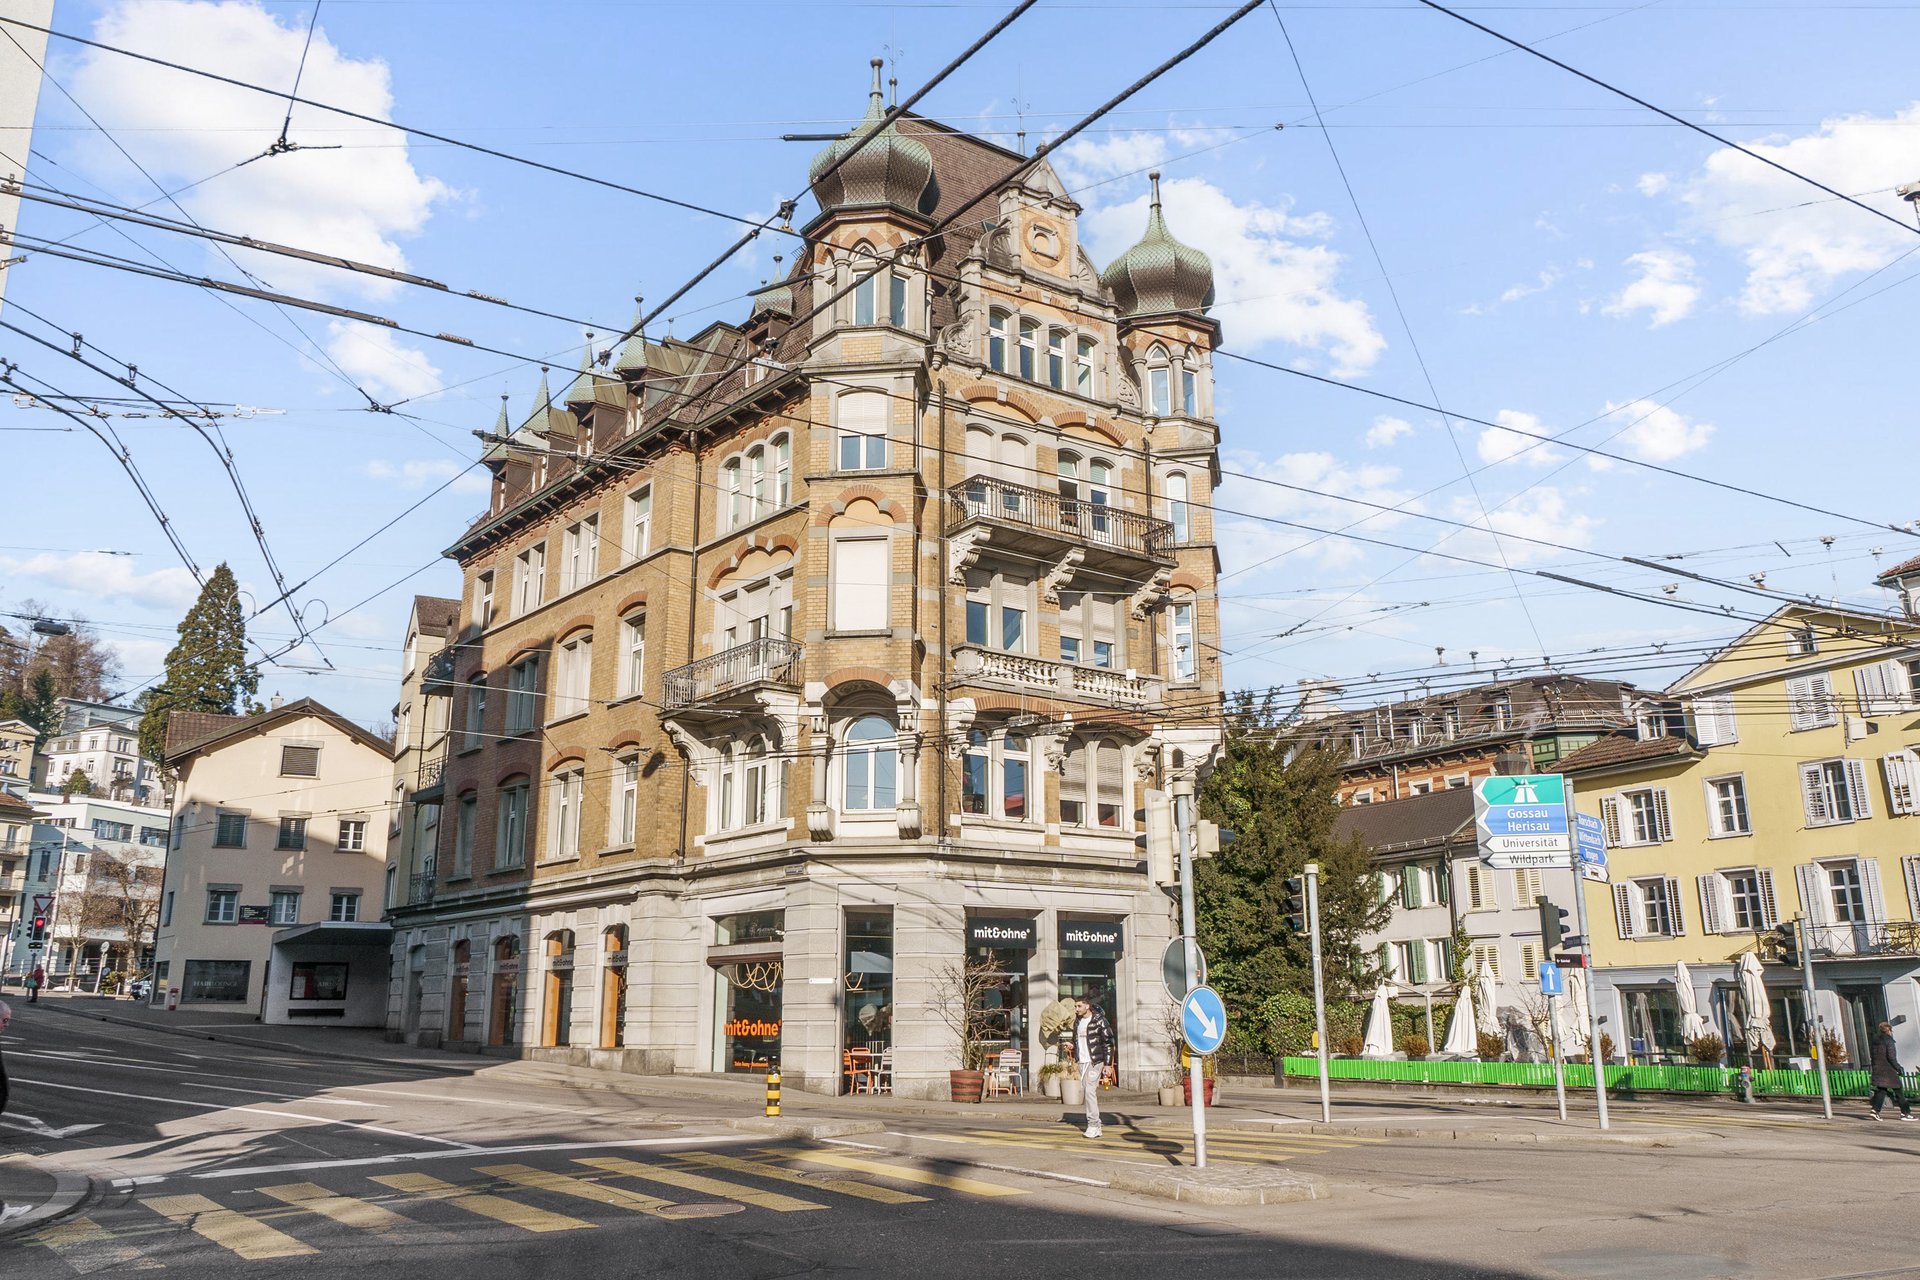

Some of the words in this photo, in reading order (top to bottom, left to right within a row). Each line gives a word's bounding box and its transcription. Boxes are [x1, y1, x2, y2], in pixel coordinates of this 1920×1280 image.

[1507, 808, 1548, 819] Gossau
[1508, 821, 1550, 832] Herisau
[1502, 838, 1558, 848] Universität
[1509, 854, 1555, 866] Wildpark
